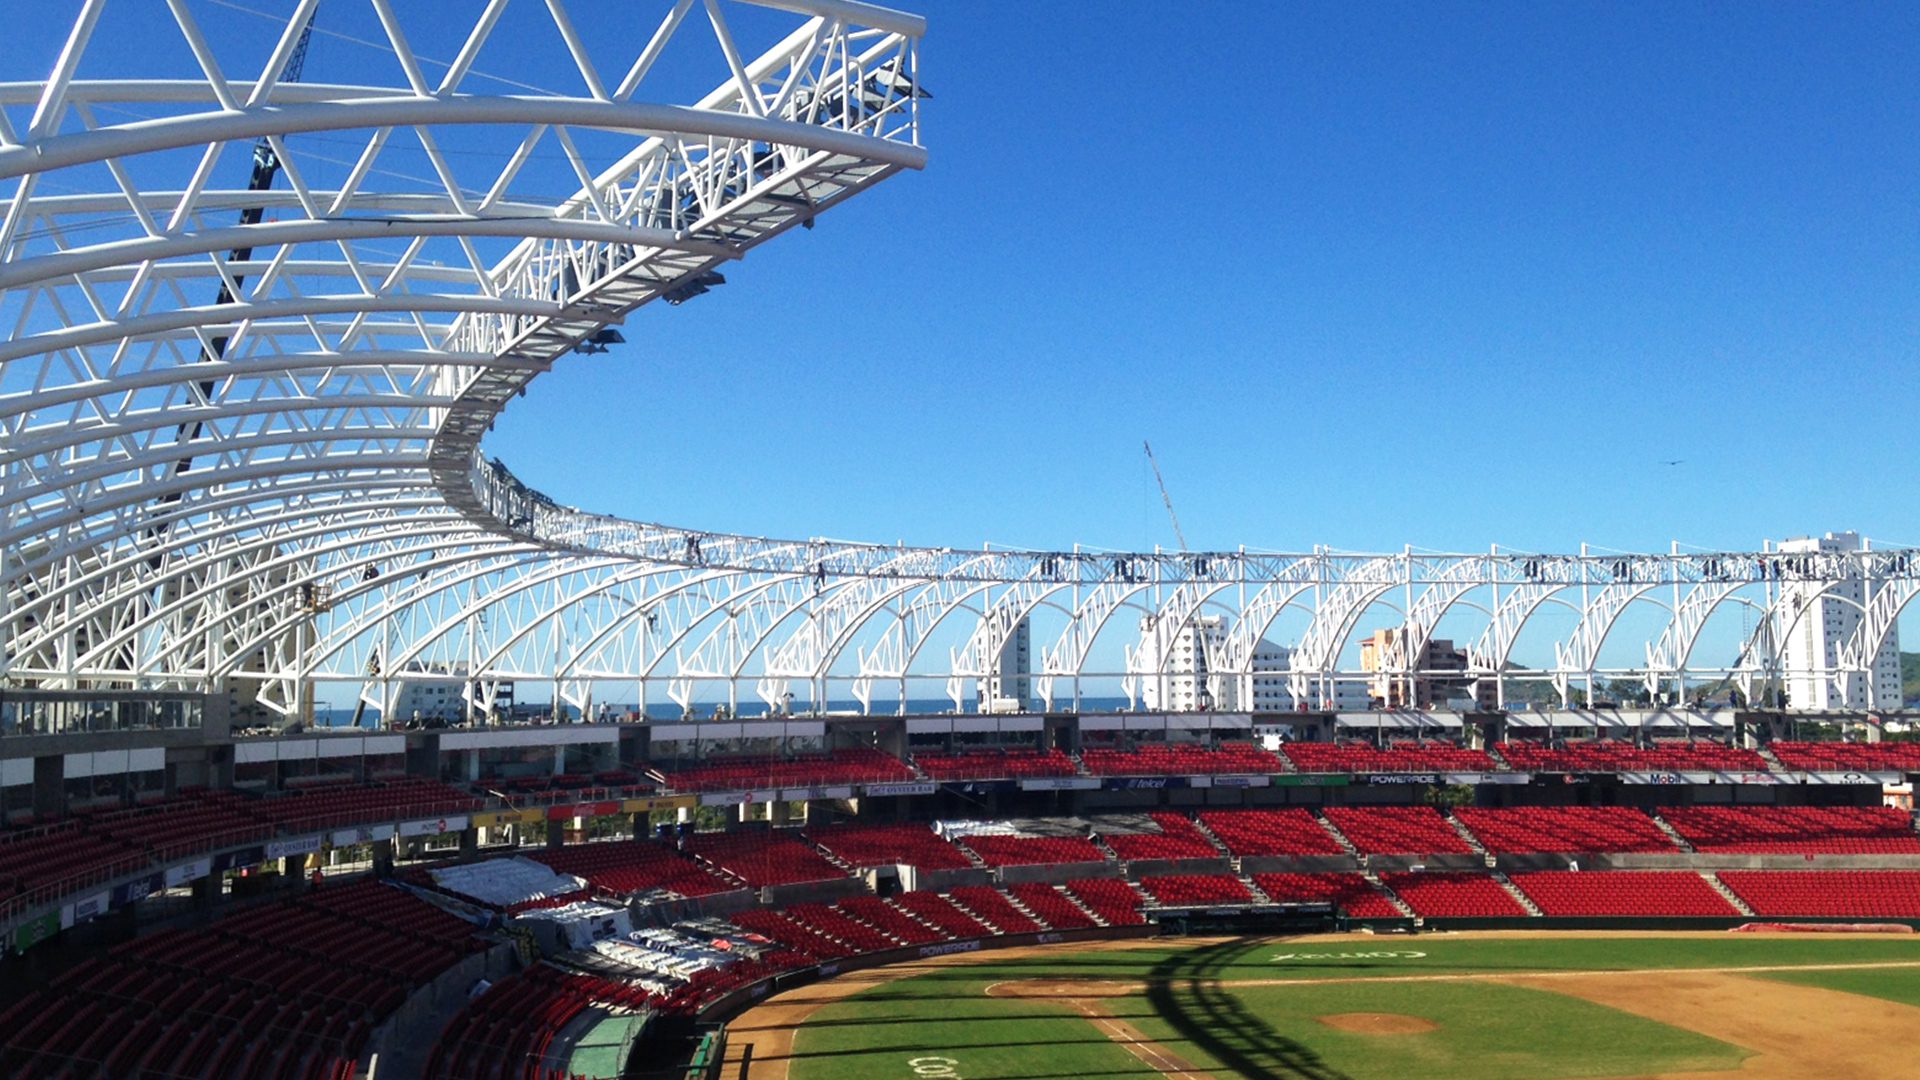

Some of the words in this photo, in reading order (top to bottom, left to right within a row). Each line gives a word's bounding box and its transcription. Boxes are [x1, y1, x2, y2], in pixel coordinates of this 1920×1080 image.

[1137, 778, 1167, 788] telcel
[1370, 774, 1436, 784] POWERADE
[1650, 773, 1681, 784] Mobil
[919, 940, 981, 956] POWERADE
